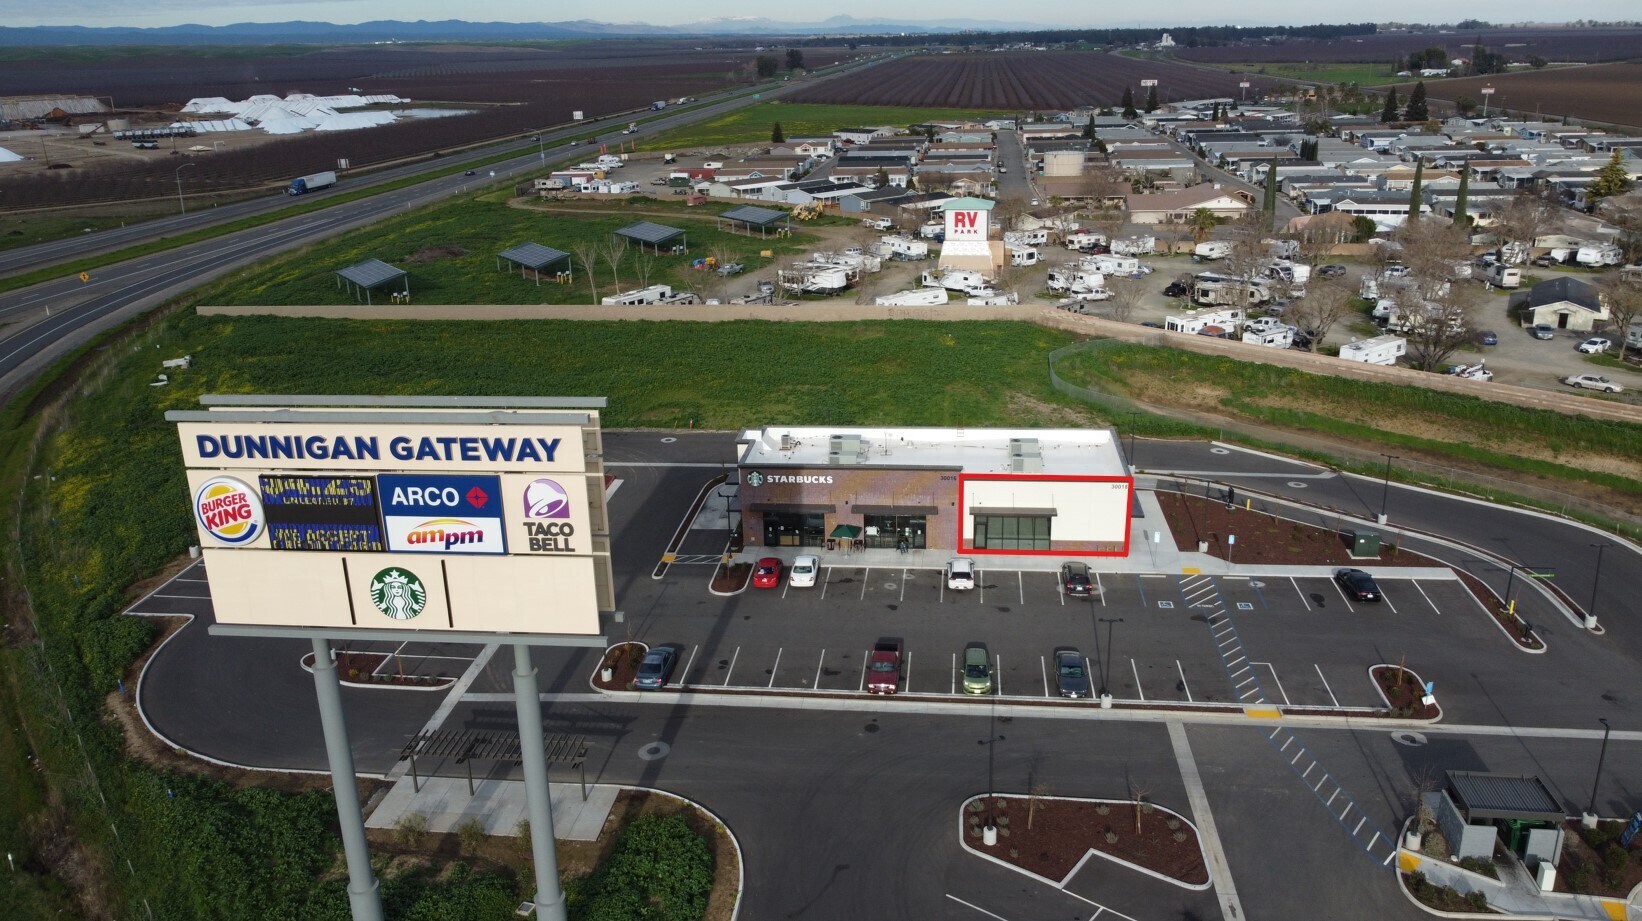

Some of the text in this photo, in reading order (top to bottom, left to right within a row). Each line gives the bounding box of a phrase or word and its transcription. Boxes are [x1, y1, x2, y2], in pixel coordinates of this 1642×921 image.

[954, 211, 978, 228] RV
[196, 434, 562, 463] DUNNIGAN GATEWAY
[766, 475, 833, 484] STARBUCKS
[201, 492, 247, 515] BURGER
[391, 486, 460, 507] ARCO
[206, 503, 252, 530] KING
[406, 528, 484, 550] ampm
[523, 522, 574, 538] TACO
[529, 537, 576, 552] BELL
